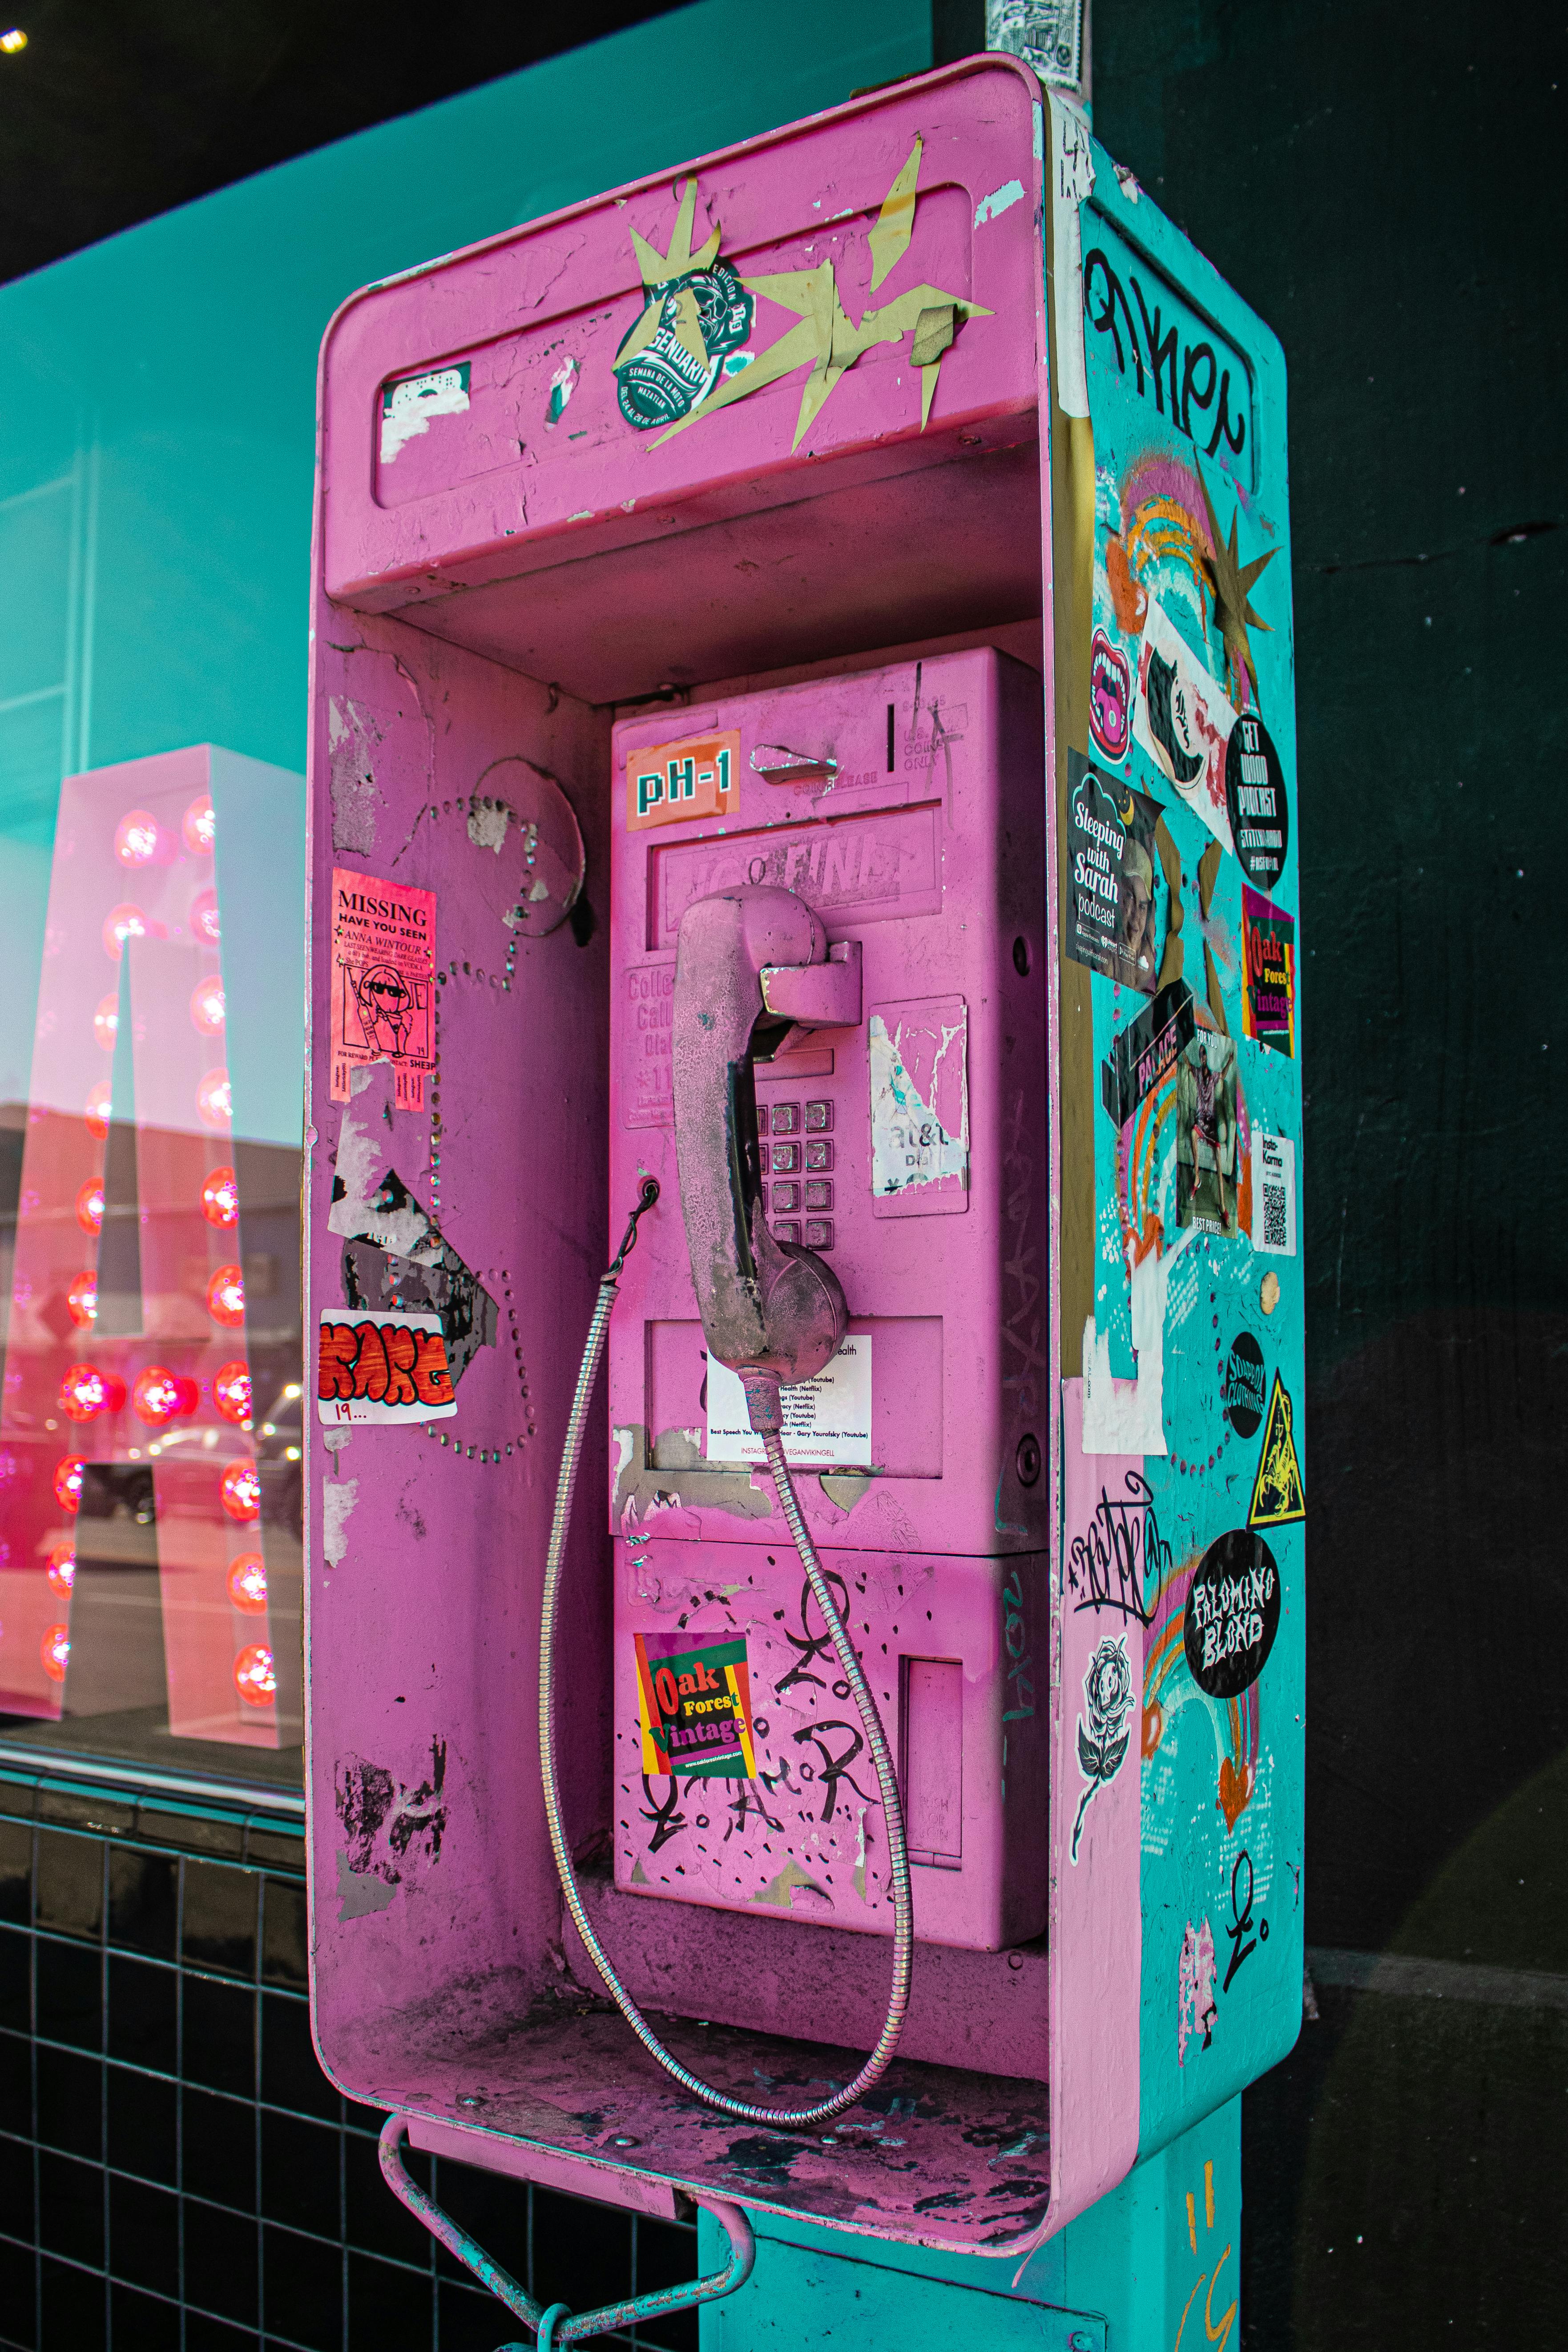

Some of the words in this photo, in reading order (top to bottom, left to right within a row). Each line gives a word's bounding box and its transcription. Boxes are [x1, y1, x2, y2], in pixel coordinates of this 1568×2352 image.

[629, 367, 655, 379] SEMANA
[656, 373, 666, 384] DE
[664, 379, 673, 390] LA
[638, 386, 666, 409] MAZATLAN
[1242, 721, 1259, 753] GET
[637, 749, 731, 817] pH-1
[1075, 802, 1124, 860] Sleeping
[1088, 847, 1109, 873] with
[1074, 852, 1118, 903] Sarah
[338, 890, 427, 926] MISSING
[1079, 894, 1115, 928] podcast
[339, 913, 370, 927] HAVE
[373, 921, 396, 933] YOU
[400, 927, 426, 940] SEEN
[345, 930, 372, 944] ANNA
[375, 937, 421, 954] WINTOUR
[1251, 926, 1282, 977] Oak
[629, 971, 673, 1000] Colle
[1265, 968, 1290, 985] Forest
[637, 1001, 673, 1030] Call
[1197, 1028, 1206, 1043] FOR
[1207, 1032, 1217, 1048] YOU
[1262, 1150, 1282, 1167] Karma
[1192, 1216, 1205, 1231] BEST
[1206, 1218, 1221, 1235] PRICE!
[1229, 1353, 1266, 1391] SOAPBOX
[1227, 1382, 1264, 1413] CLOTHING
[1192, 1566, 1275, 1631] PALOMINO
[1201, 1613, 1265, 1671] BLOND
[656, 1662, 719, 1715] Oak
[683, 1692, 739, 1716] Forest
[649, 1718, 746, 1753] Vintage
[685, 1751, 742, 1768] www.oakforestvintage.com
